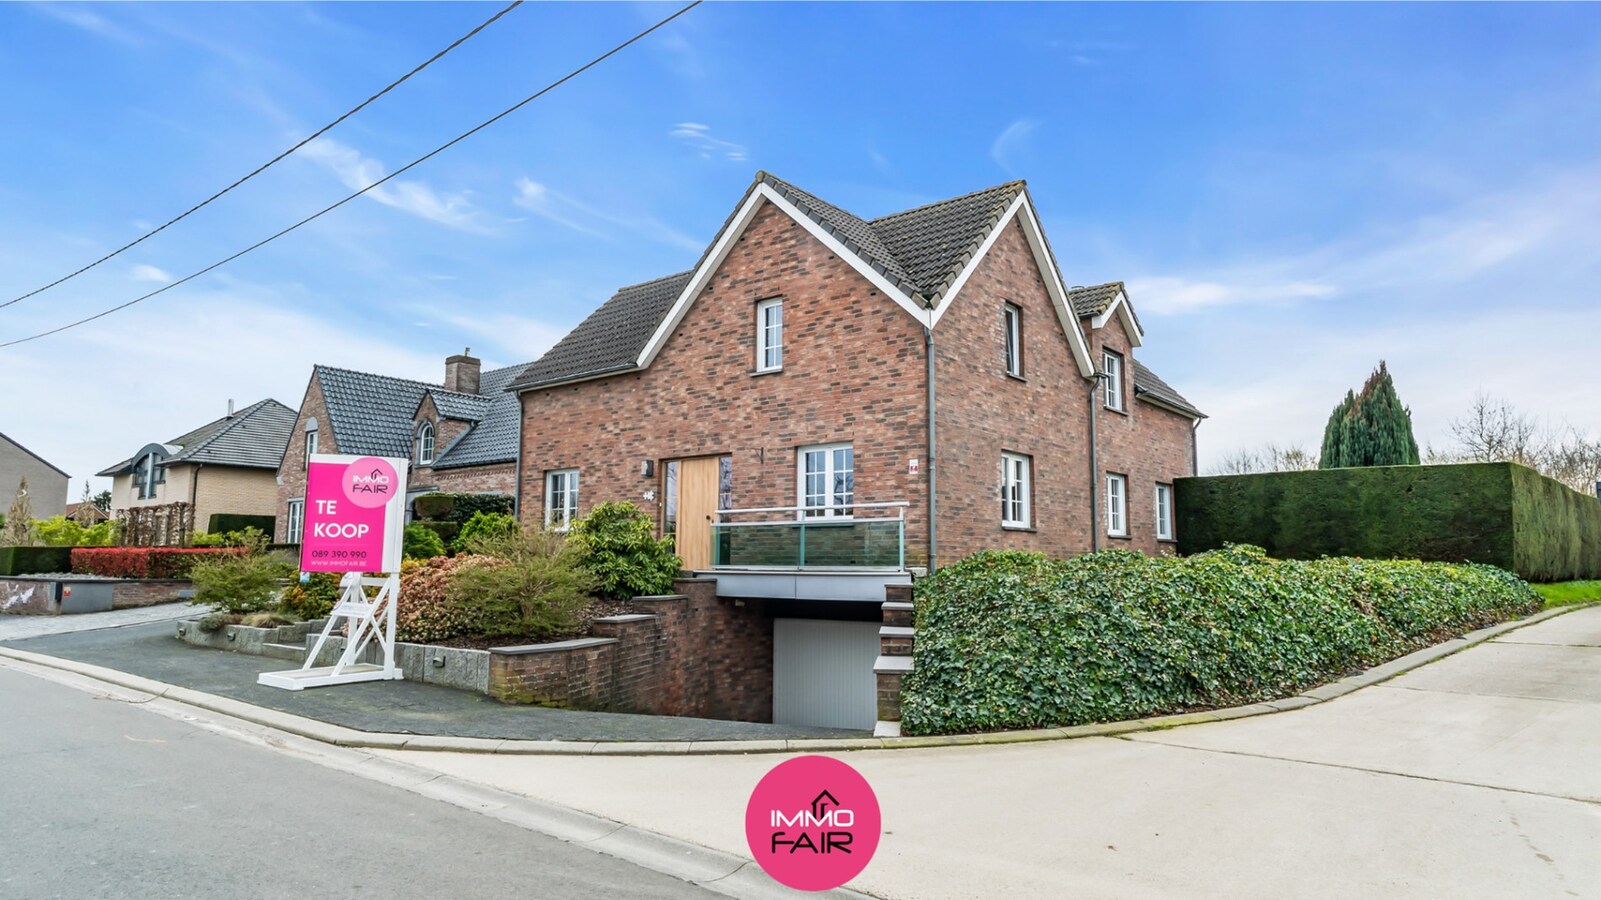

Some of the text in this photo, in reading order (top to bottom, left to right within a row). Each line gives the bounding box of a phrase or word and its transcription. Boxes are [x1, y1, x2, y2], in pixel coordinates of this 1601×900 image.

[352, 475, 389, 484] IMMO
[352, 484, 388, 494] FAIR
[315, 499, 337, 515] TE
[313, 522, 369, 538] KOOP
[311, 550, 328, 558] 089
[331, 550, 348, 558] 390
